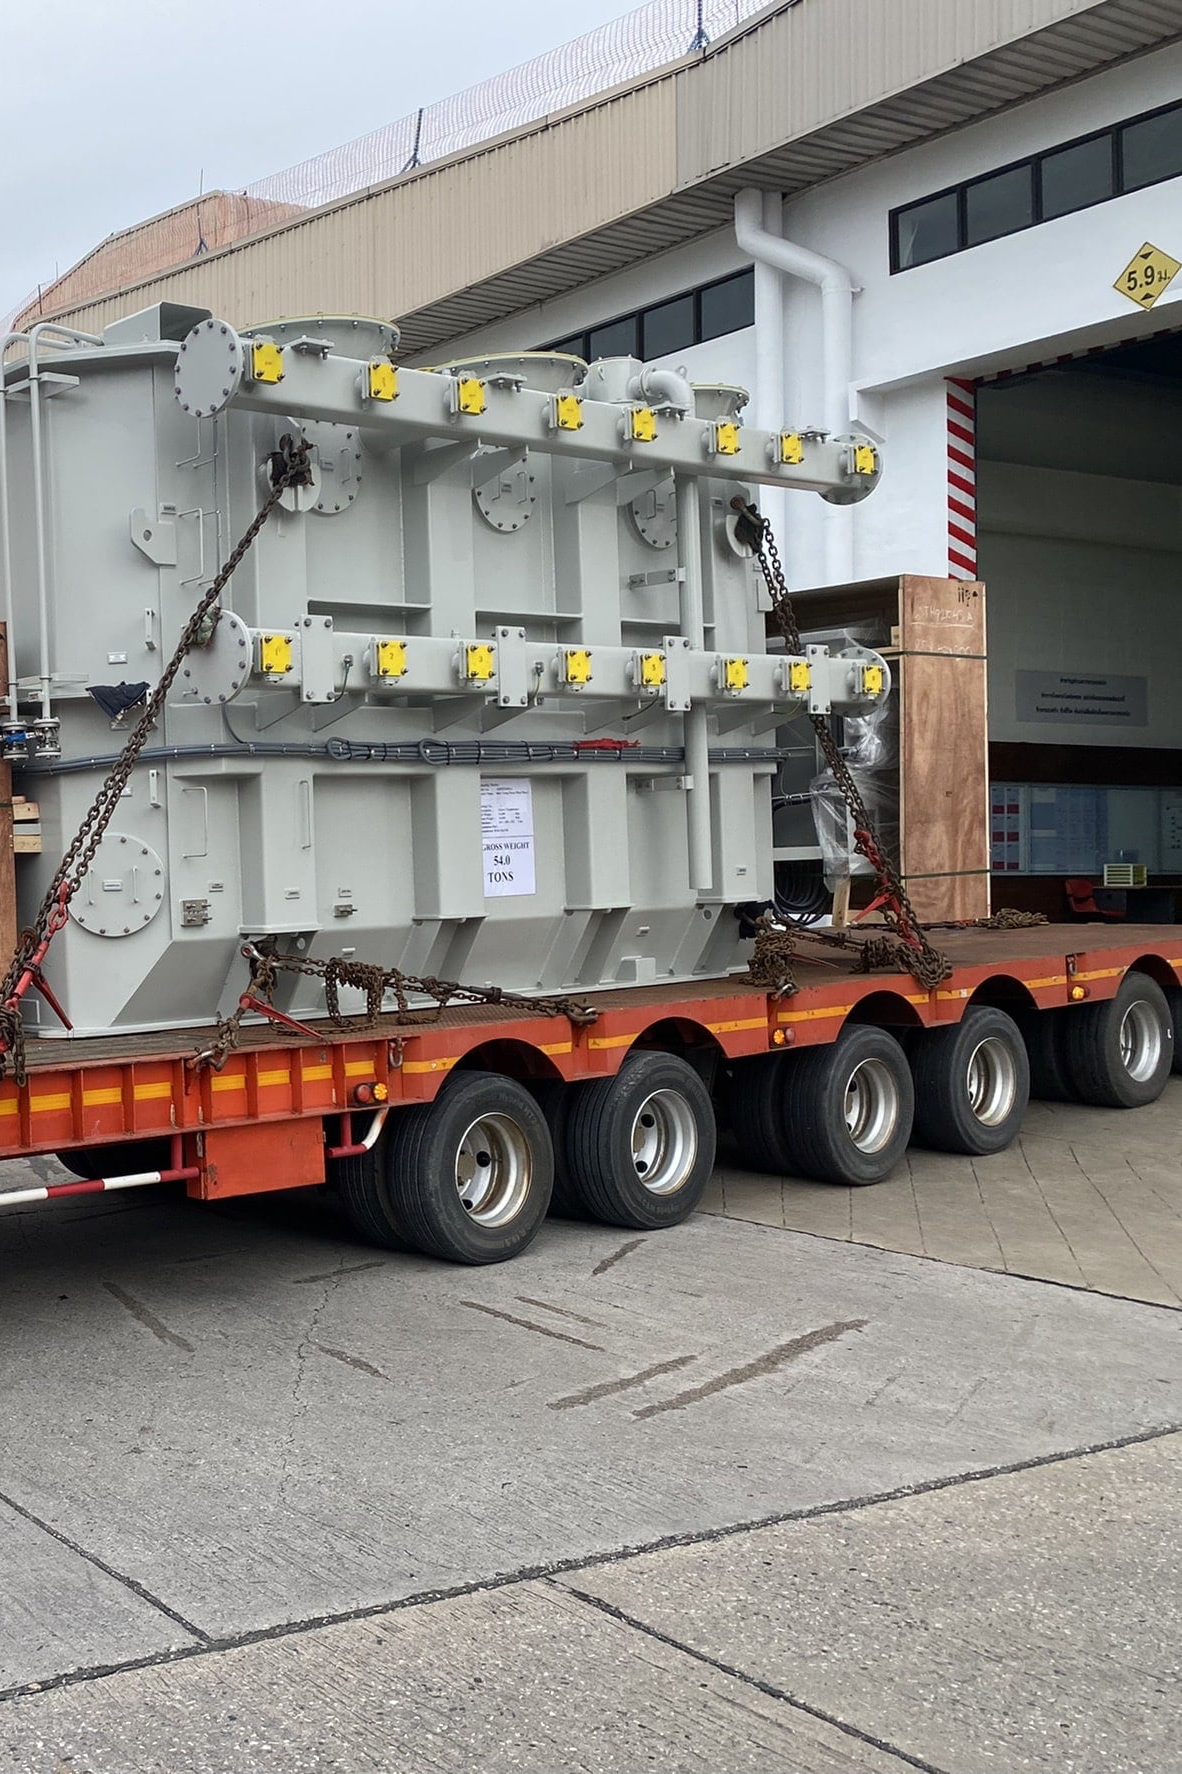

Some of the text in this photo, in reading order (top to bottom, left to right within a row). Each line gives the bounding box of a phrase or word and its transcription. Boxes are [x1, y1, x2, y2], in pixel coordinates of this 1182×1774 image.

[1127, 265, 1155, 291] 5.9
[503, 841, 530, 850] WEIGHT
[493, 854, 511, 866] 54.0
[487, 870, 514, 883] TONS
